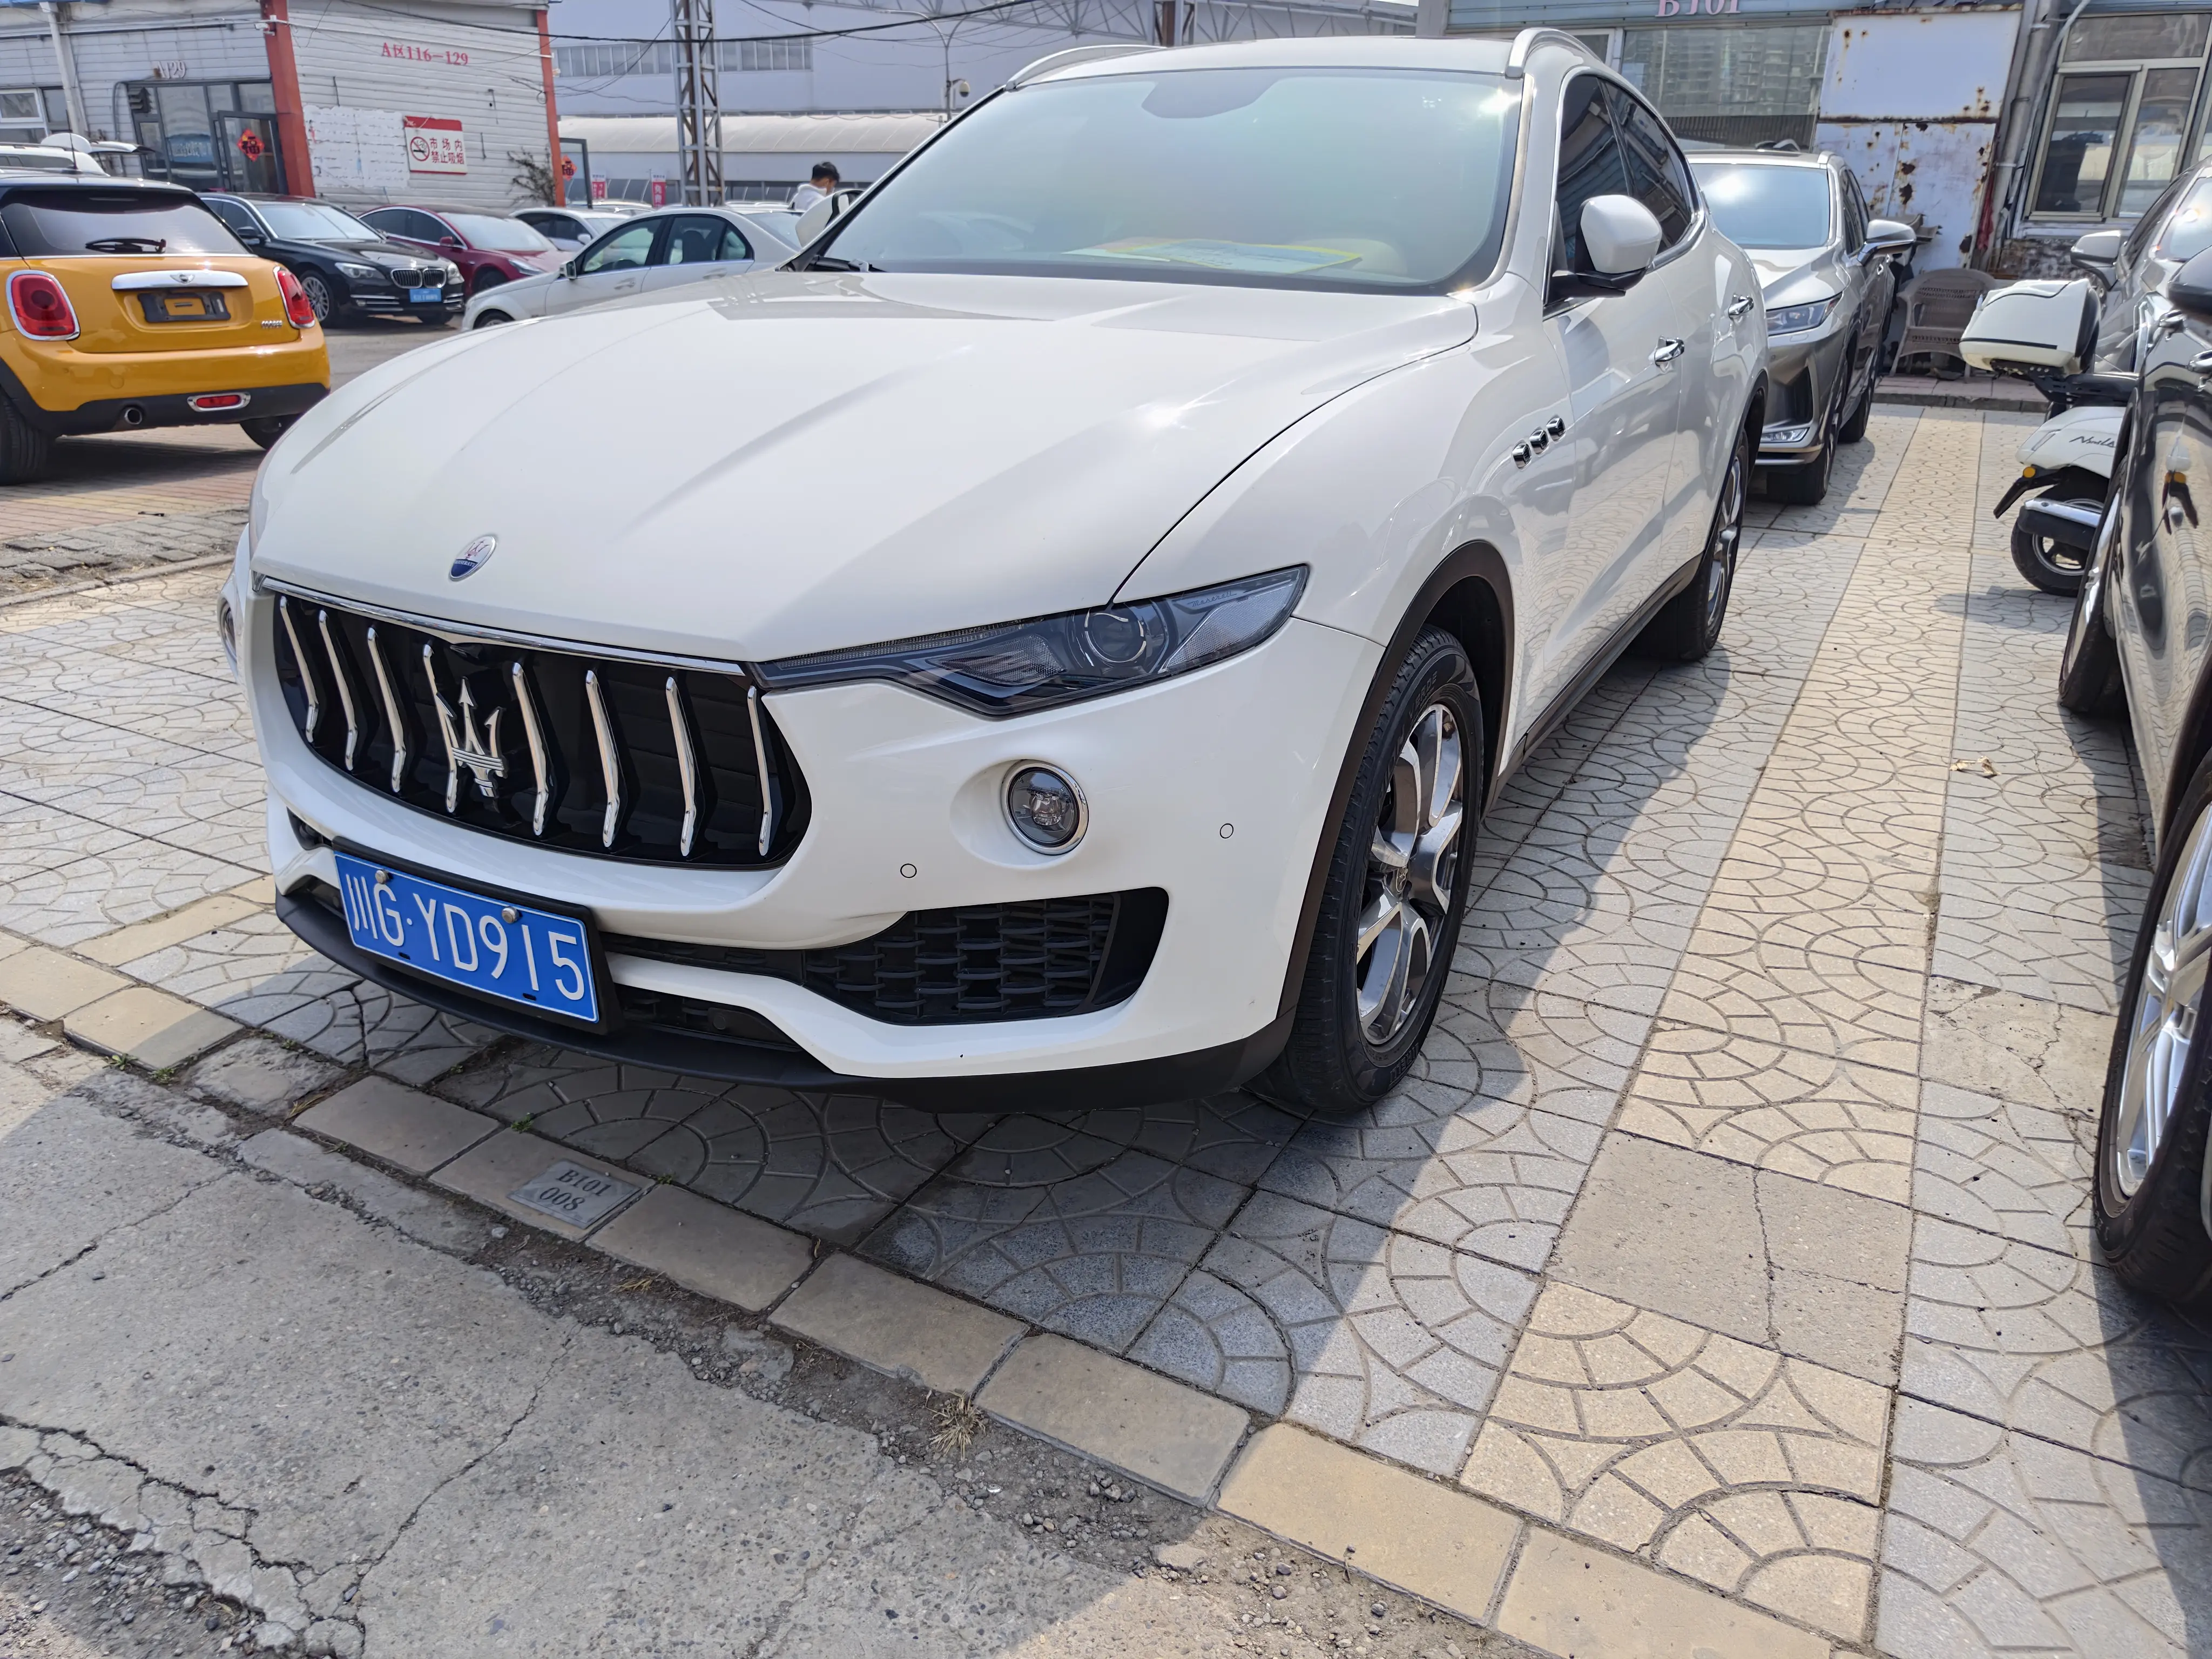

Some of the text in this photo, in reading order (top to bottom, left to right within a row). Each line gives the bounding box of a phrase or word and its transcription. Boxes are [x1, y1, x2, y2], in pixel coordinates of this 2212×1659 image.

[429, 137, 463, 152] 市场内
[431, 151, 464, 165] 禁止吸烟
[1187, 590, 1237, 608] Maserati
[555, 1169, 612, 1197] B101
[539, 1187, 585, 1211] 008
